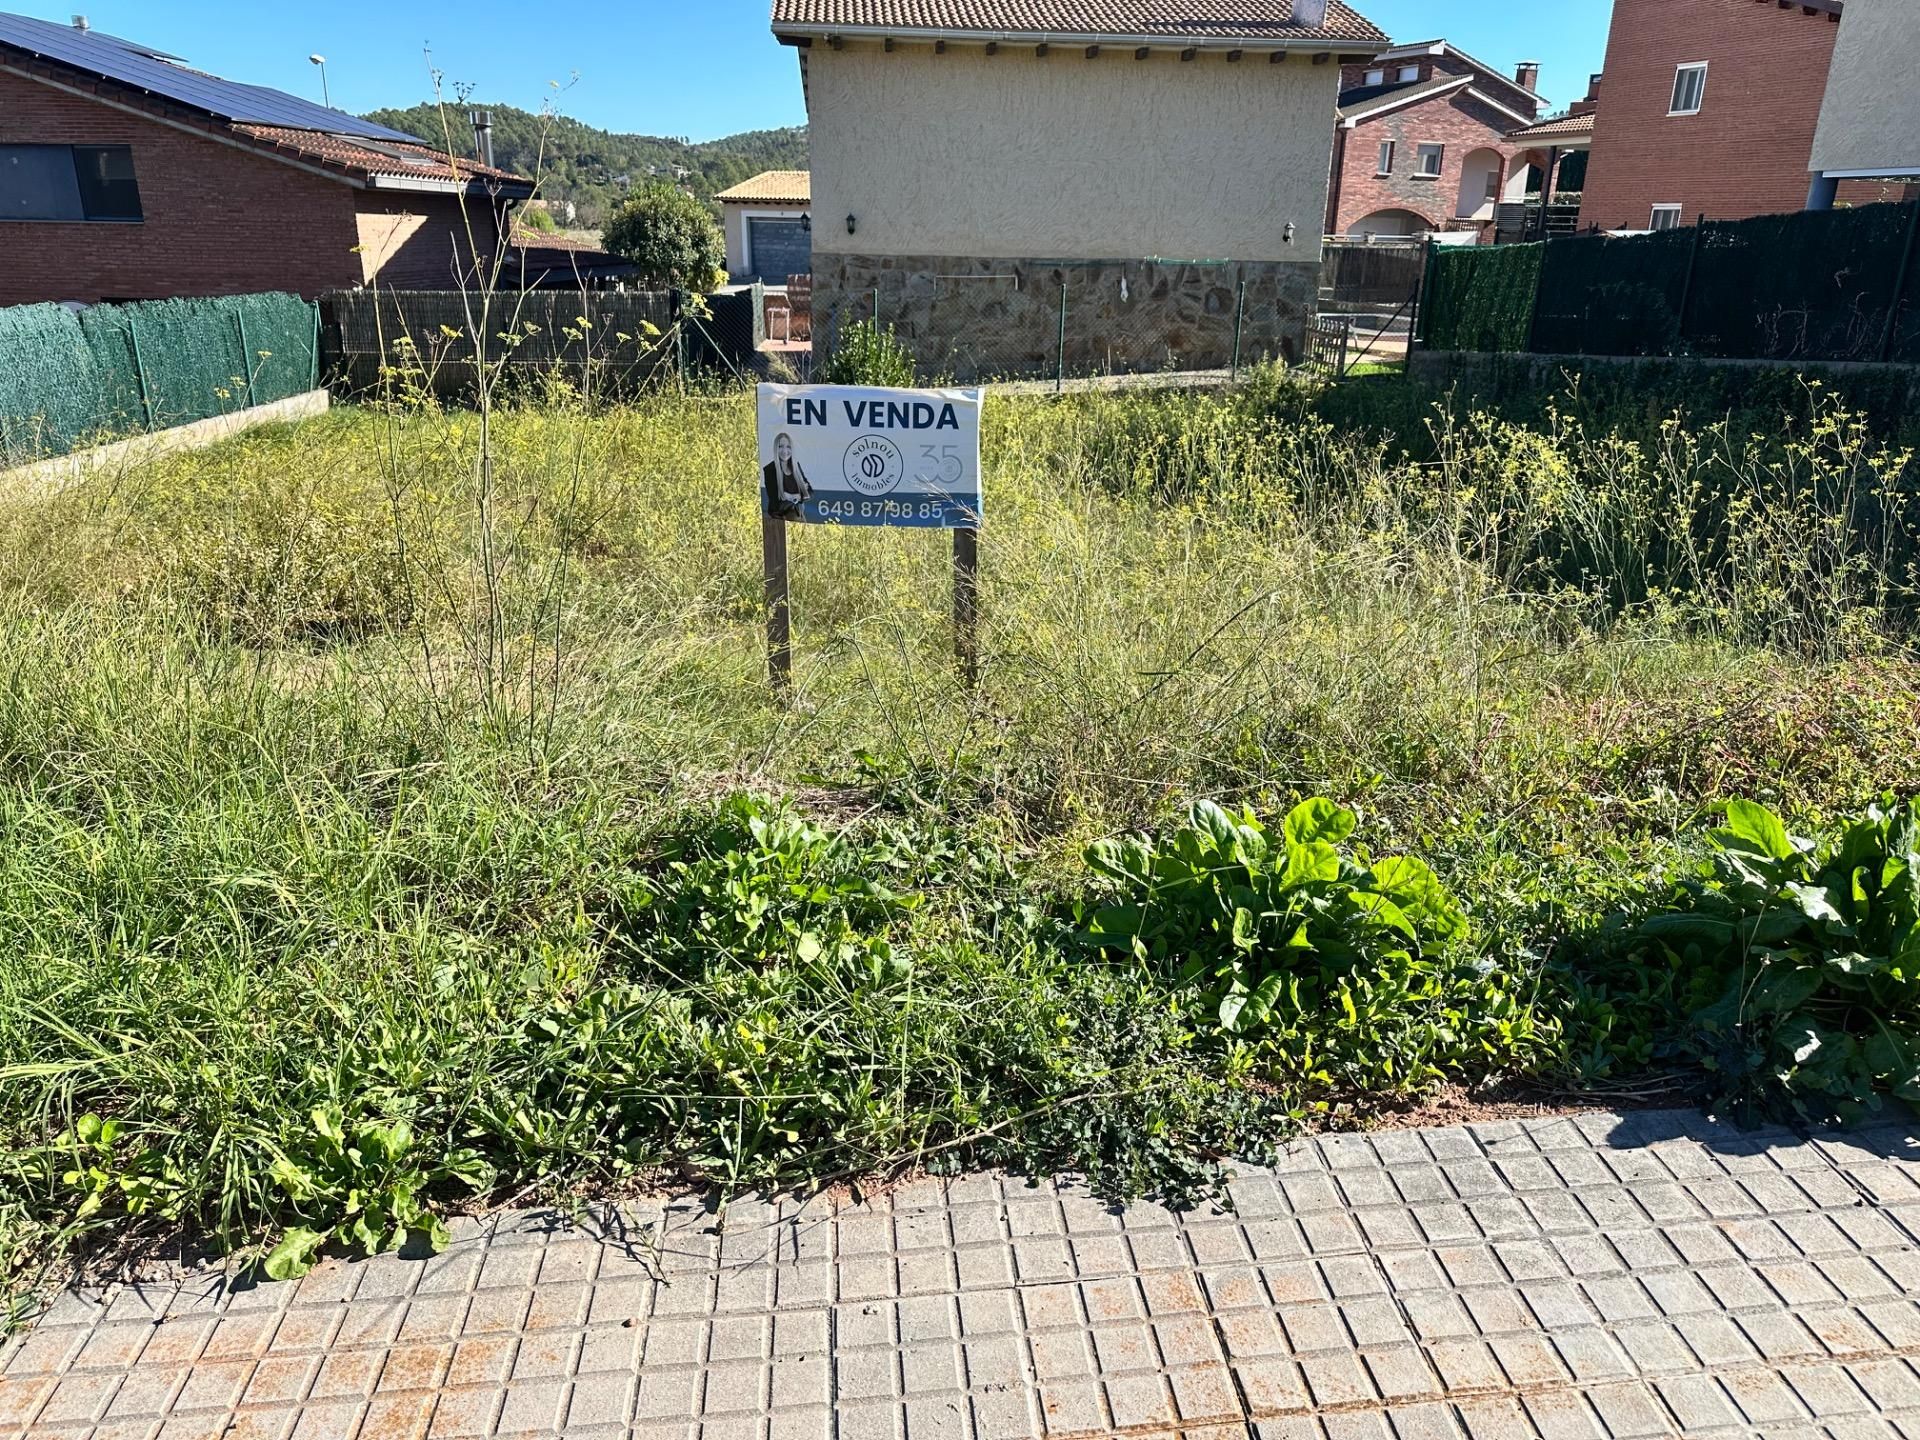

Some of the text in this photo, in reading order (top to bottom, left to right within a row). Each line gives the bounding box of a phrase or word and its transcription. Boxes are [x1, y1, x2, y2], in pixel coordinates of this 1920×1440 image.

[786, 398, 959, 430] EN VENDA
[852, 438, 895, 460] solnou
[913, 444, 963, 484] 35
[851, 472, 895, 491] immobles
[818, 499, 943, 519] 649 87 98 85
